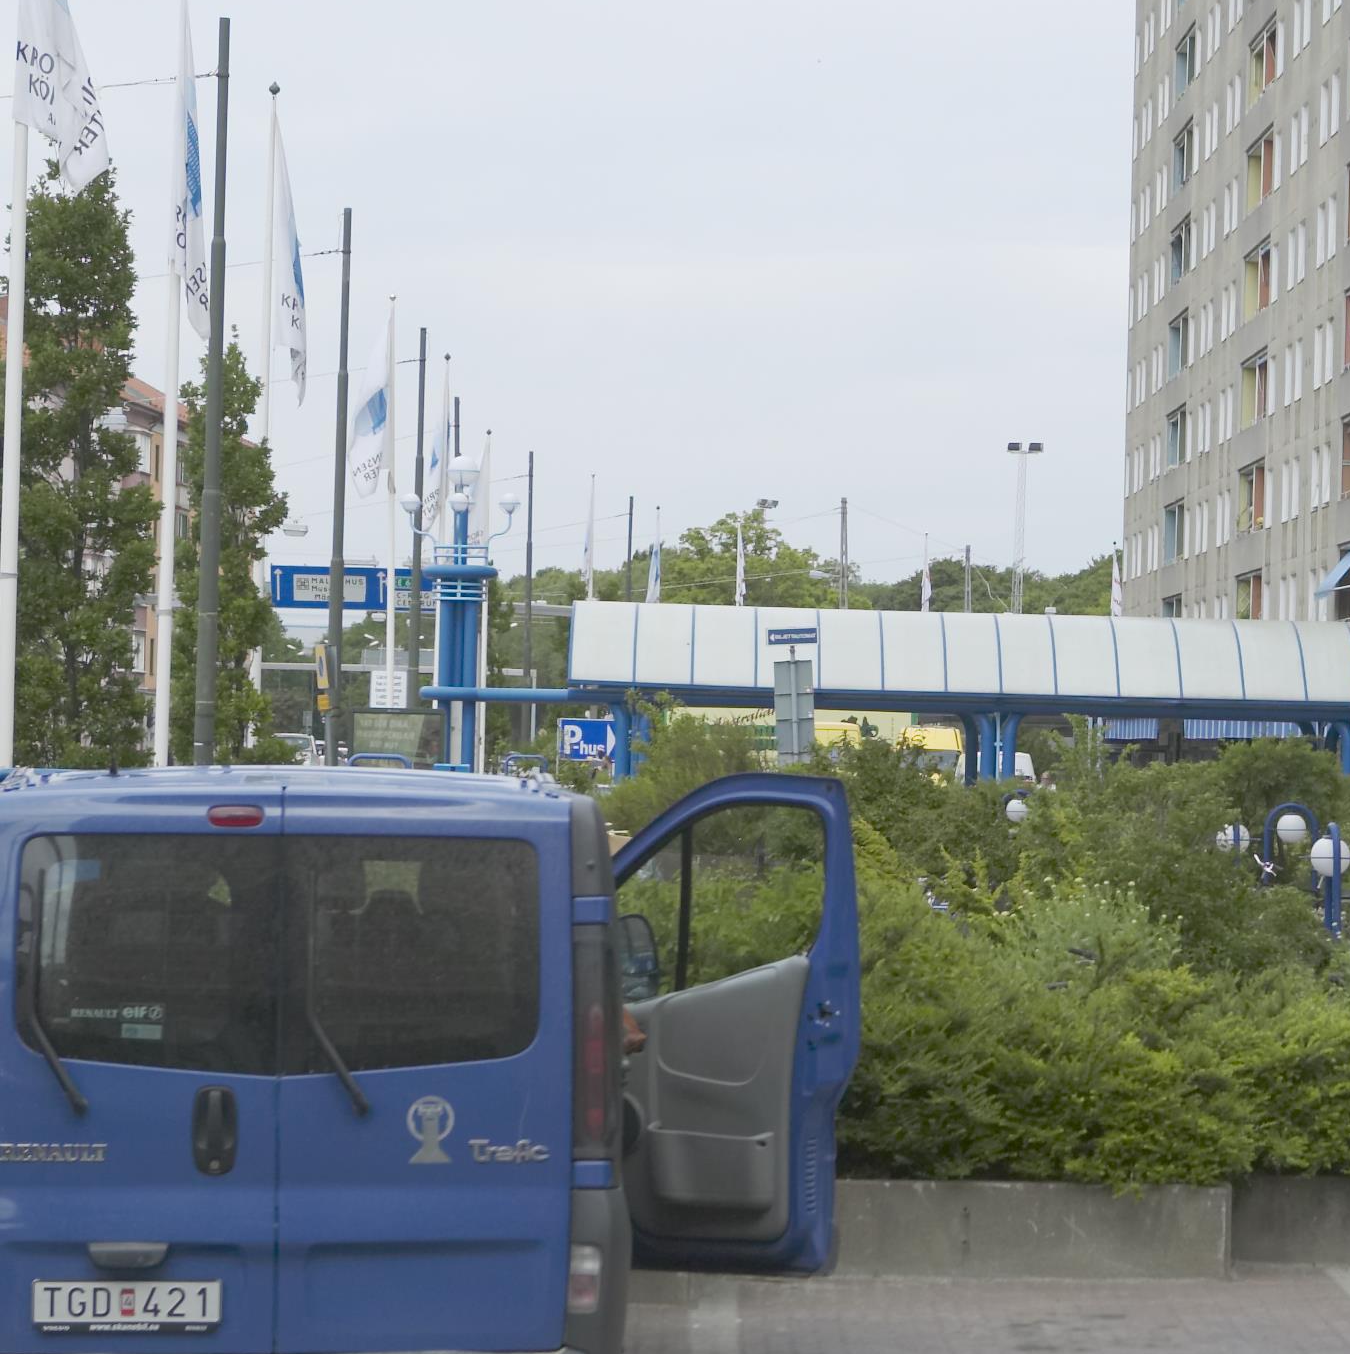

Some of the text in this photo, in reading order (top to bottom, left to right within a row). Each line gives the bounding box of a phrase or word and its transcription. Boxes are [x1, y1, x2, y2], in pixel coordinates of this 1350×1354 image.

[311, 577, 364, 586] MALHUS
[563, 725, 606, 755] P-hus
[121, 1006, 148, 1019] elf
[0, 1143, 108, 1162] RENAULT
[468, 1139, 551, 1164] Trafic
[43, 1286, 112, 1318] TGD
[142, 1286, 208, 1318] 421
